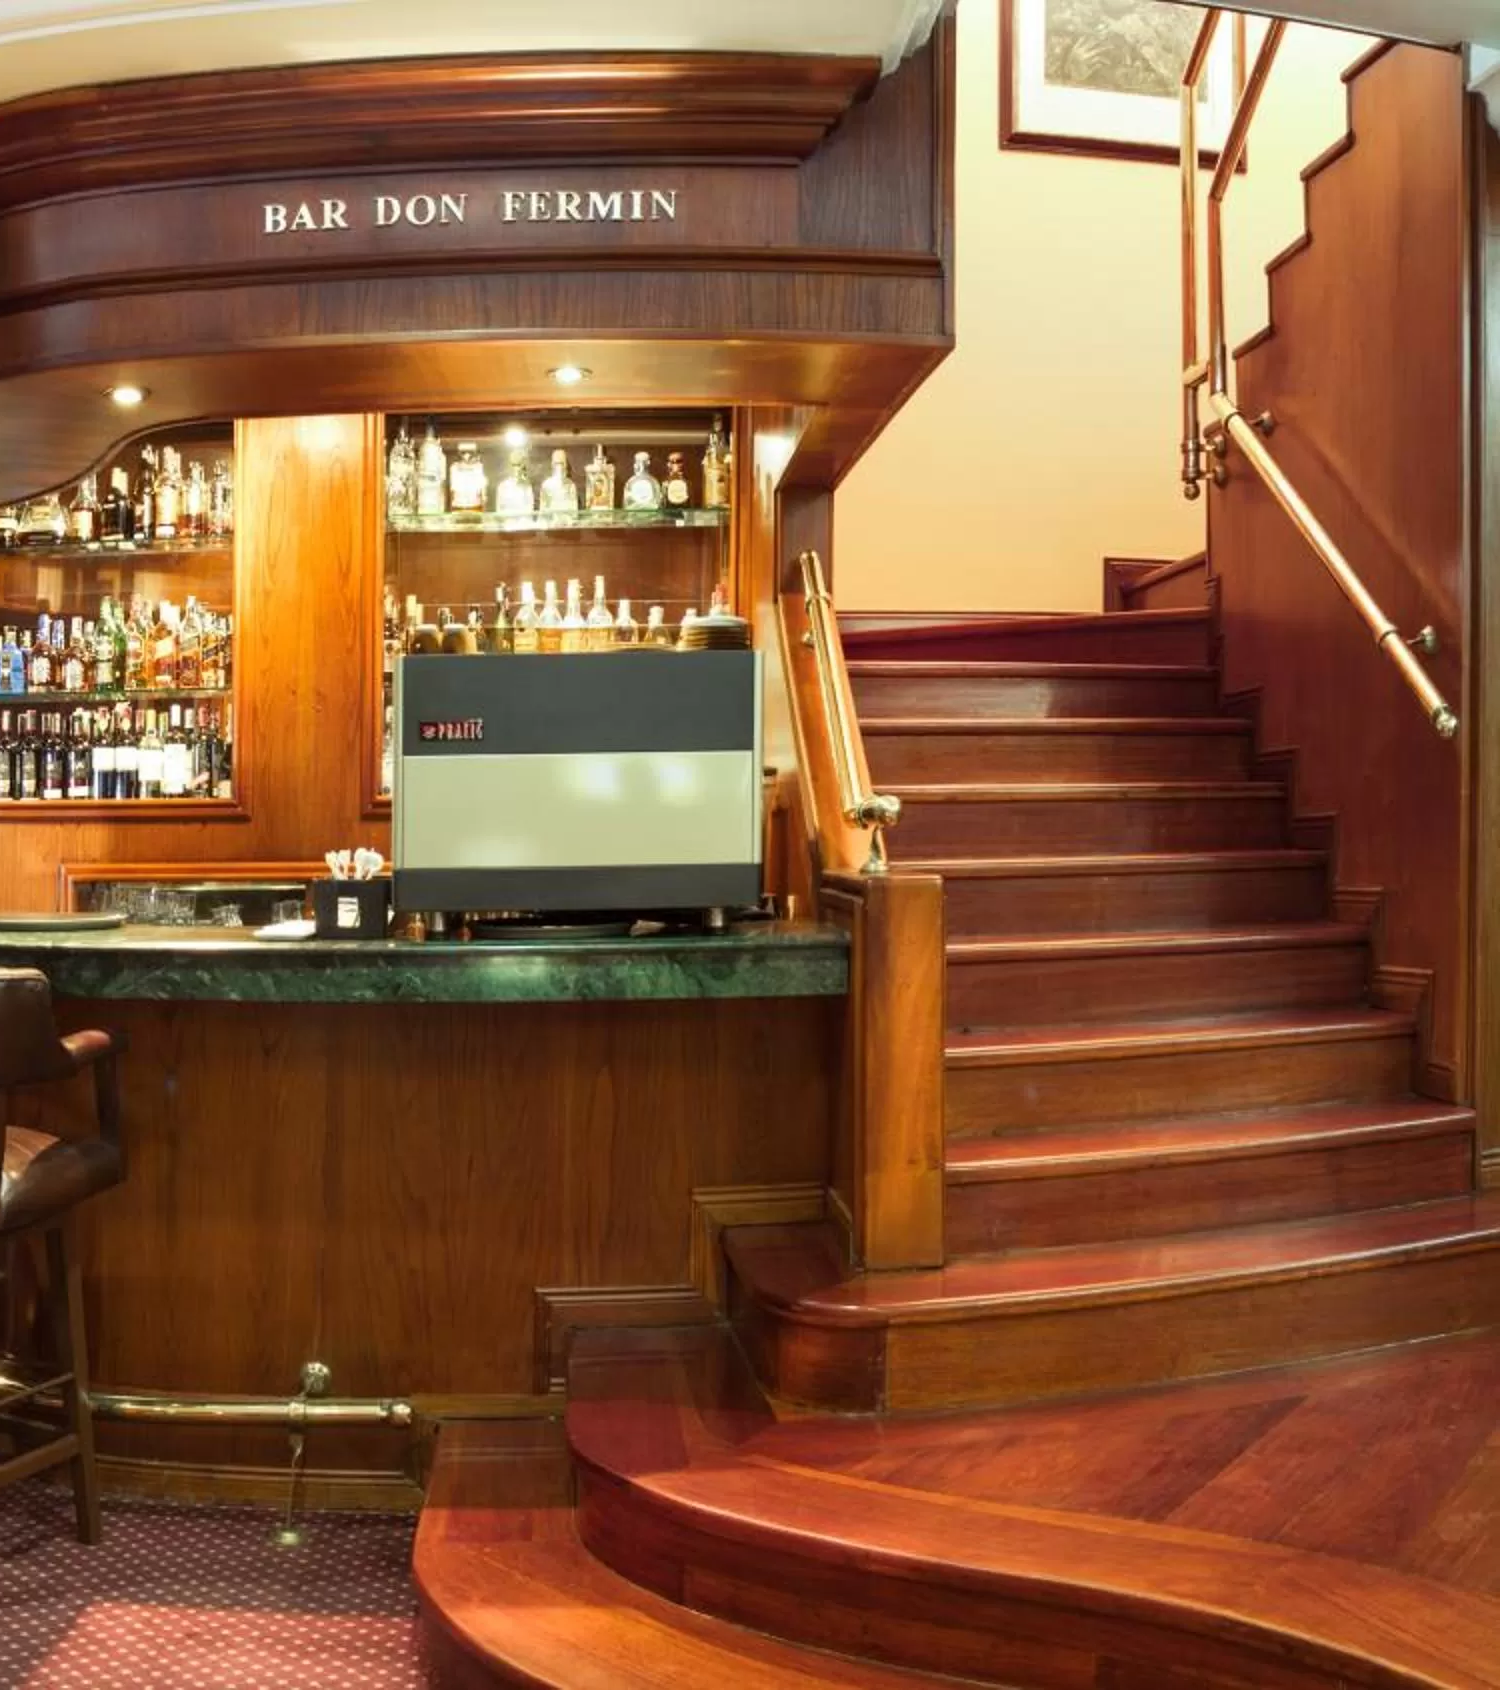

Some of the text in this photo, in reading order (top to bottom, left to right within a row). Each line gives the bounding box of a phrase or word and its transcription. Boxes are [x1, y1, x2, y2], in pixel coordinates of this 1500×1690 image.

[262, 189, 677, 233] BAR DON FERMIN
